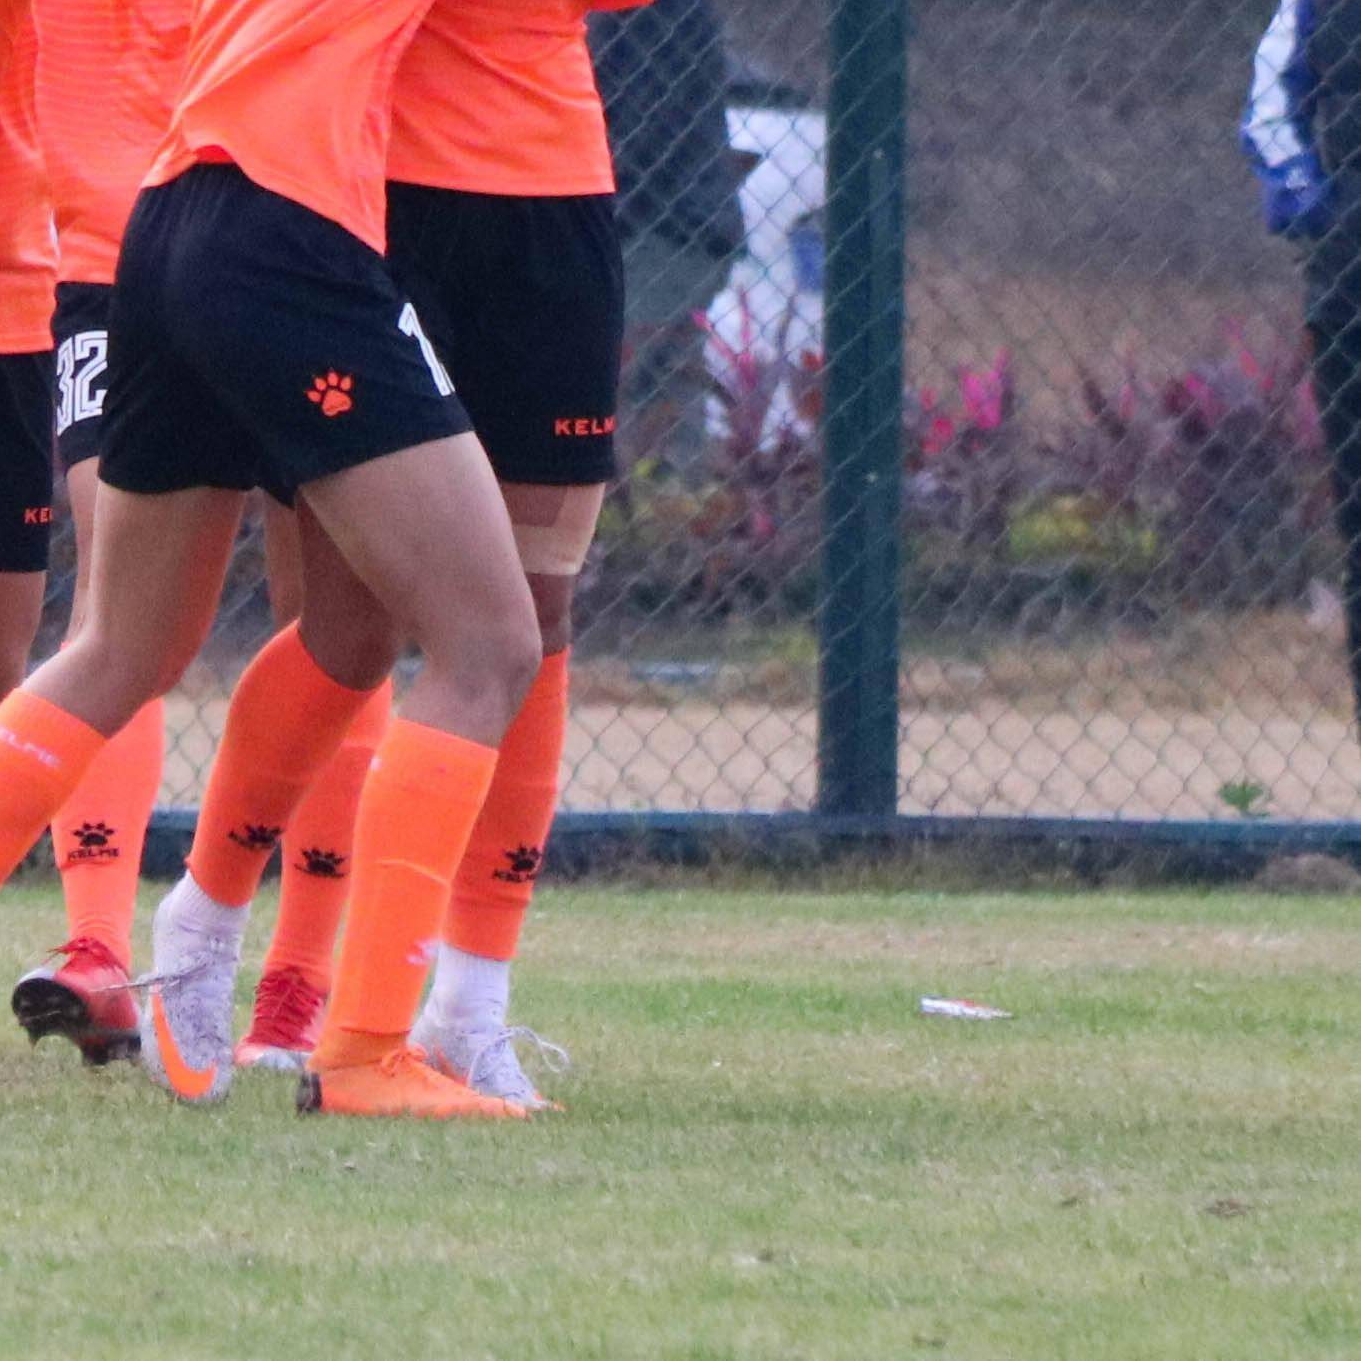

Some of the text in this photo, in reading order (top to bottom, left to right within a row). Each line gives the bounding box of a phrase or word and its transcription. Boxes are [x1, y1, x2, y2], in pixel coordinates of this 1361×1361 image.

[57, 330, 107, 436] 32
[398, 302, 455, 397] 1
[68, 848, 119, 861] KELME
